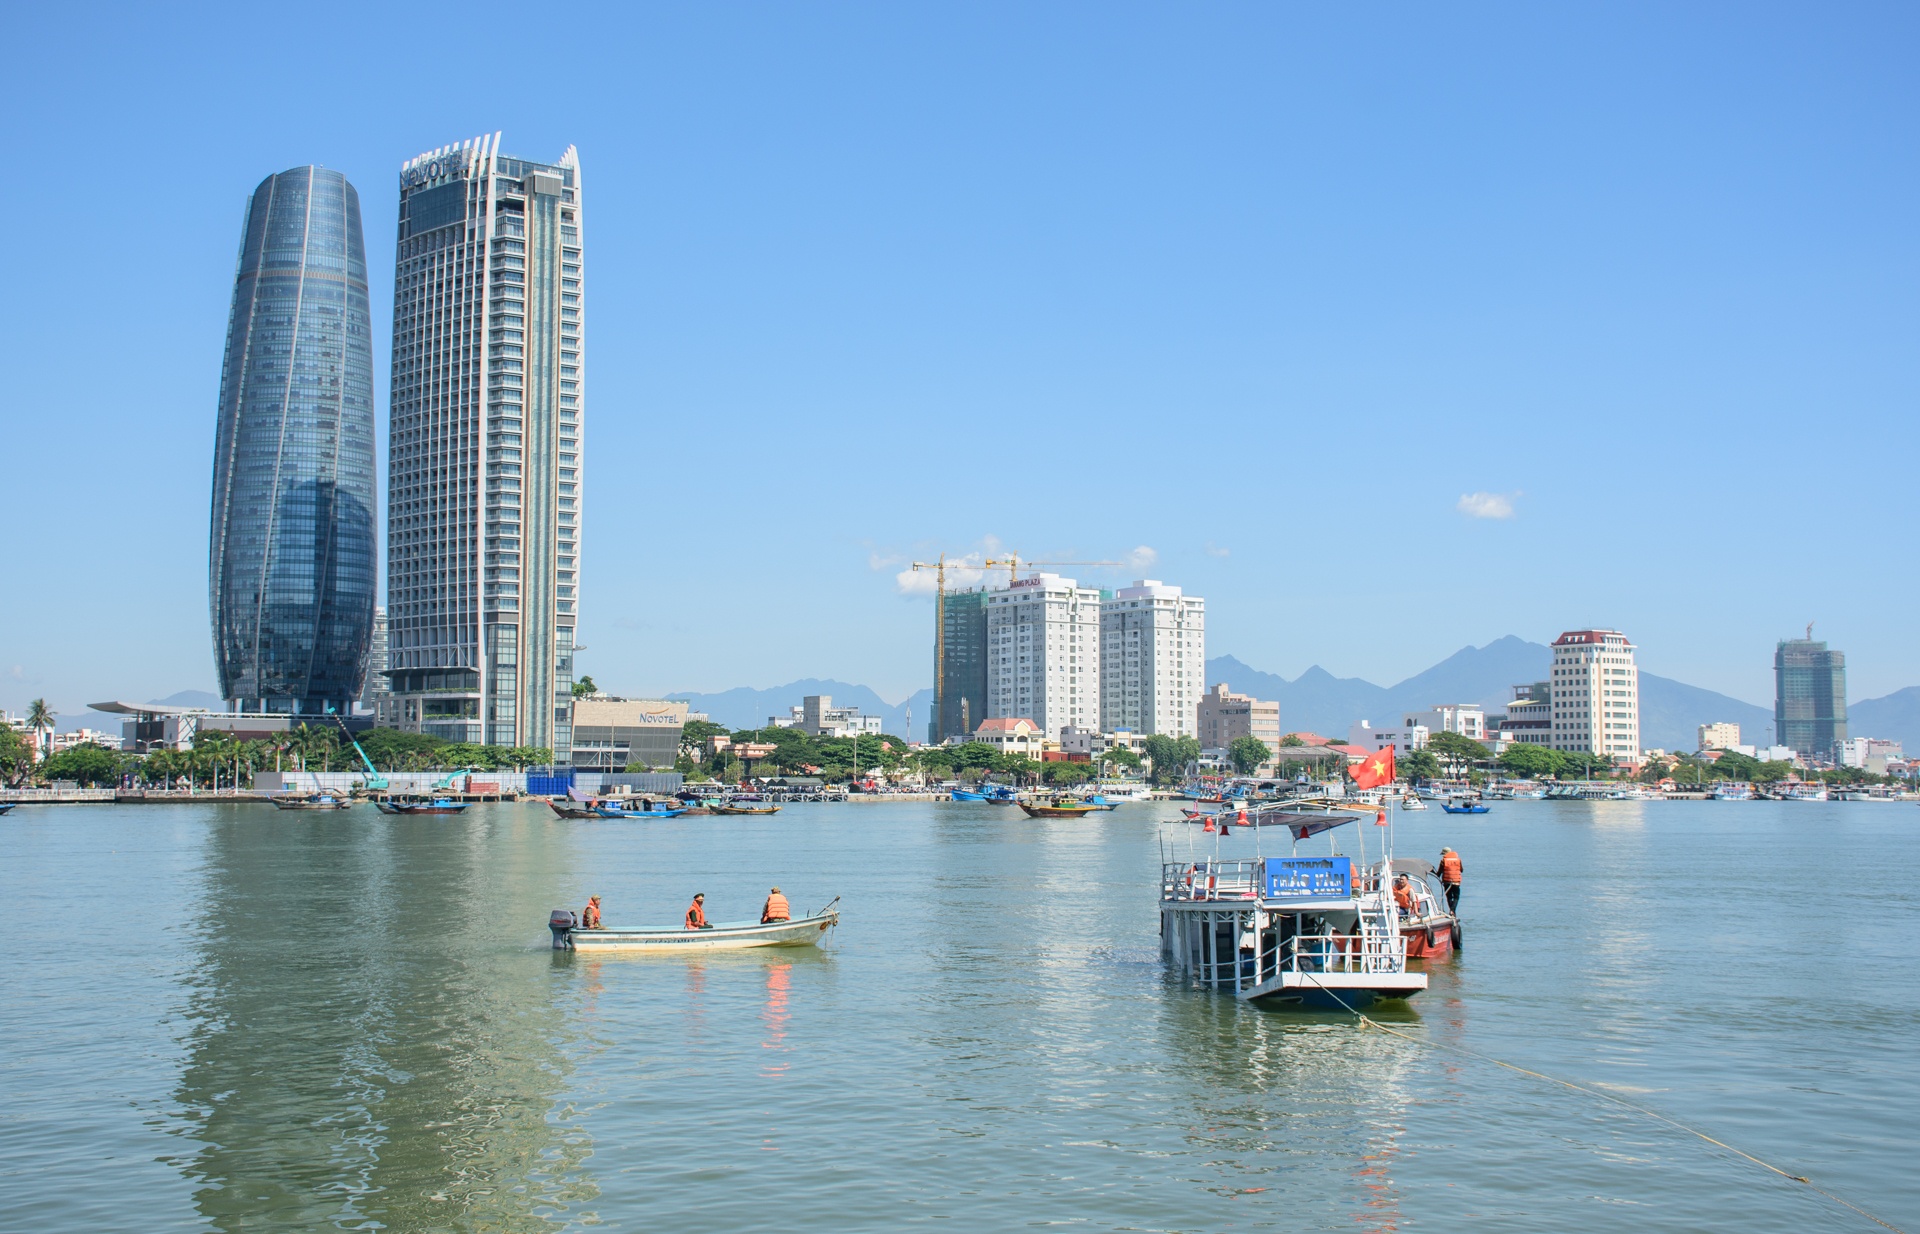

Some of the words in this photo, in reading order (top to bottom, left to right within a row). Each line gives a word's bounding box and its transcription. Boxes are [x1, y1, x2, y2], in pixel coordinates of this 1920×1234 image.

[1025, 578, 1041, 586] PLAZA
[640, 713, 679, 723] NOVOTEL
[1272, 870, 1310, 887] THẢO
